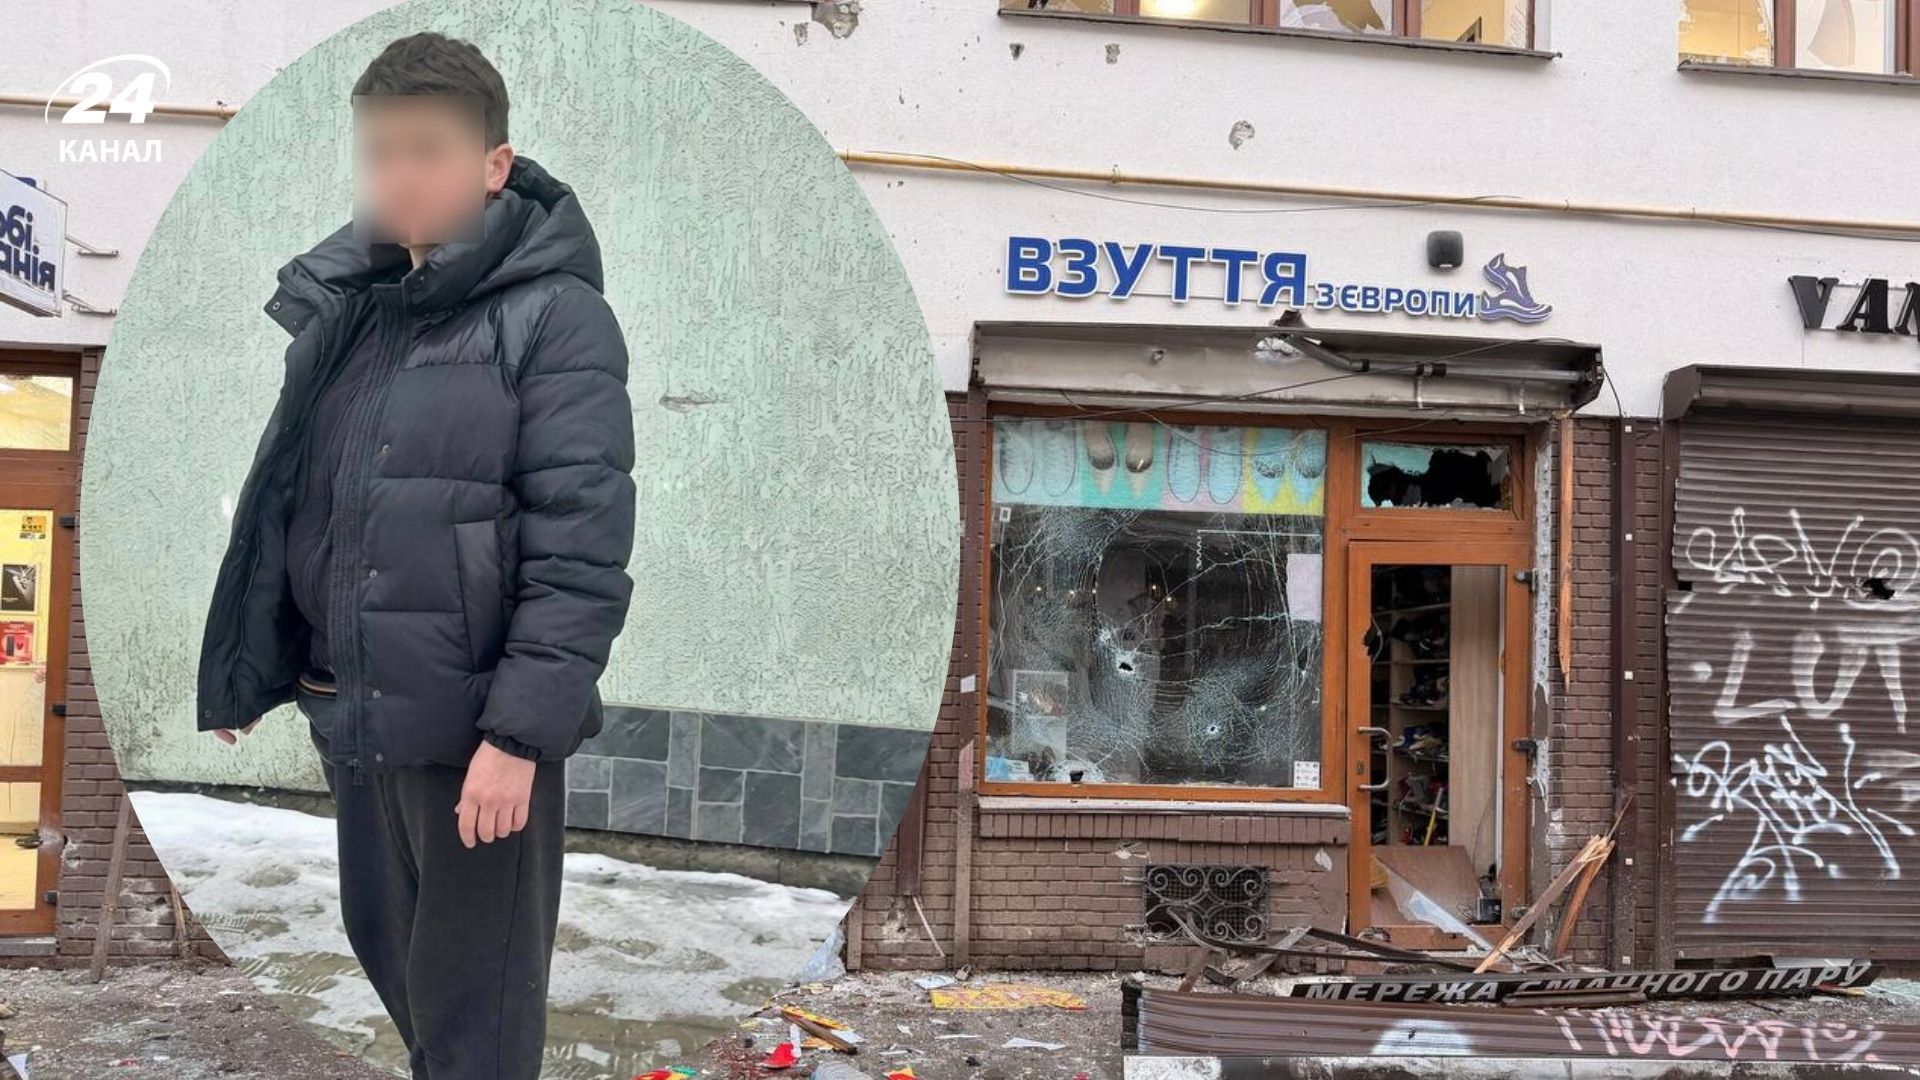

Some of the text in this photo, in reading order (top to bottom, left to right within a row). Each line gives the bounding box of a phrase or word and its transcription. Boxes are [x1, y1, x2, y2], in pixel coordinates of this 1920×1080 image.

[1006, 235, 1308, 308] ВЗУТТЯ
[1305, 980, 1499, 1003] МЕРЕЖА
[1755, 958, 1872, 990] ПАРУ
